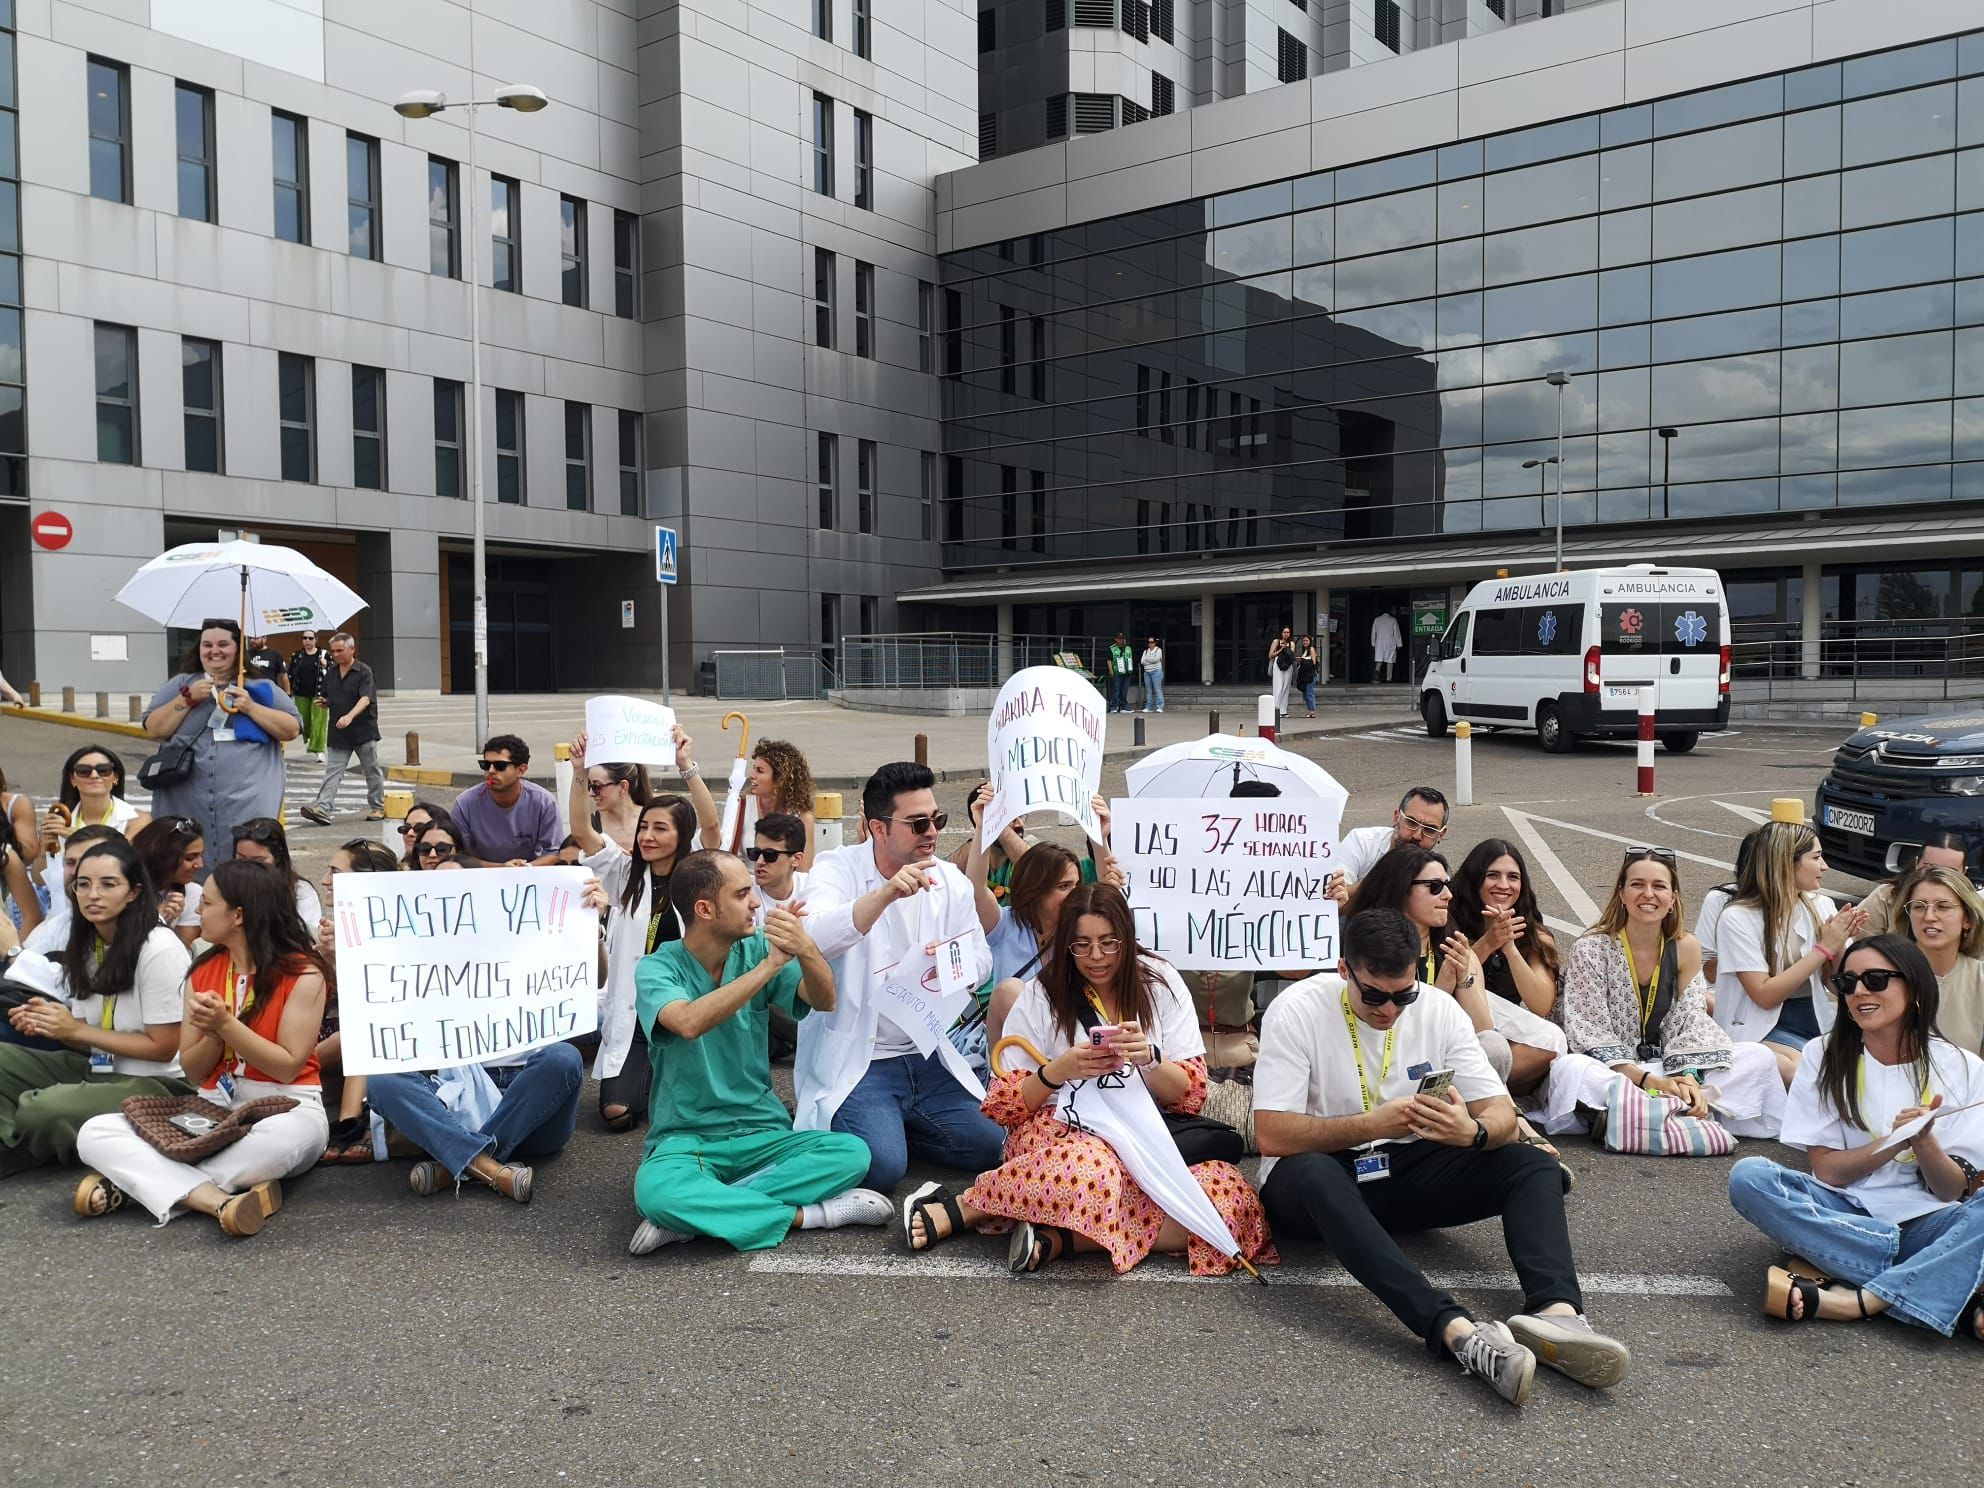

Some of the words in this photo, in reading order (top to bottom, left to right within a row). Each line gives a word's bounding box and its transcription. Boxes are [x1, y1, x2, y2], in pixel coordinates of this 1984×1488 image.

[1495, 581, 1569, 602] AMBULANCIA
[1618, 584, 1696, 593] AMBULANCIA
[1008, 736, 1087, 778] MÉDICOS
[1135, 822, 1178, 855] LAS
[1201, 814, 1242, 855] 37
[1255, 812, 1307, 834] HORAS
[1828, 809, 1874, 833] CNP2200RZ
[1242, 840, 1331, 858] SEMANALES
[1191, 867, 1230, 896] LAS
[1243, 868, 1333, 900] ALCANZO
[1187, 903, 1332, 965] MIÉRCOLES
[363, 961, 510, 1003] ESTAMOS
[526, 961, 588, 996] HASTA
[886, 983, 926, 1013] ESTATUTO
[1343, 1002, 1351, 1015] MIR
[369, 1021, 417, 1061] LOS
[436, 998, 576, 1059] FONENDOS
[1349, 1022, 1359, 1049] MEDICO
